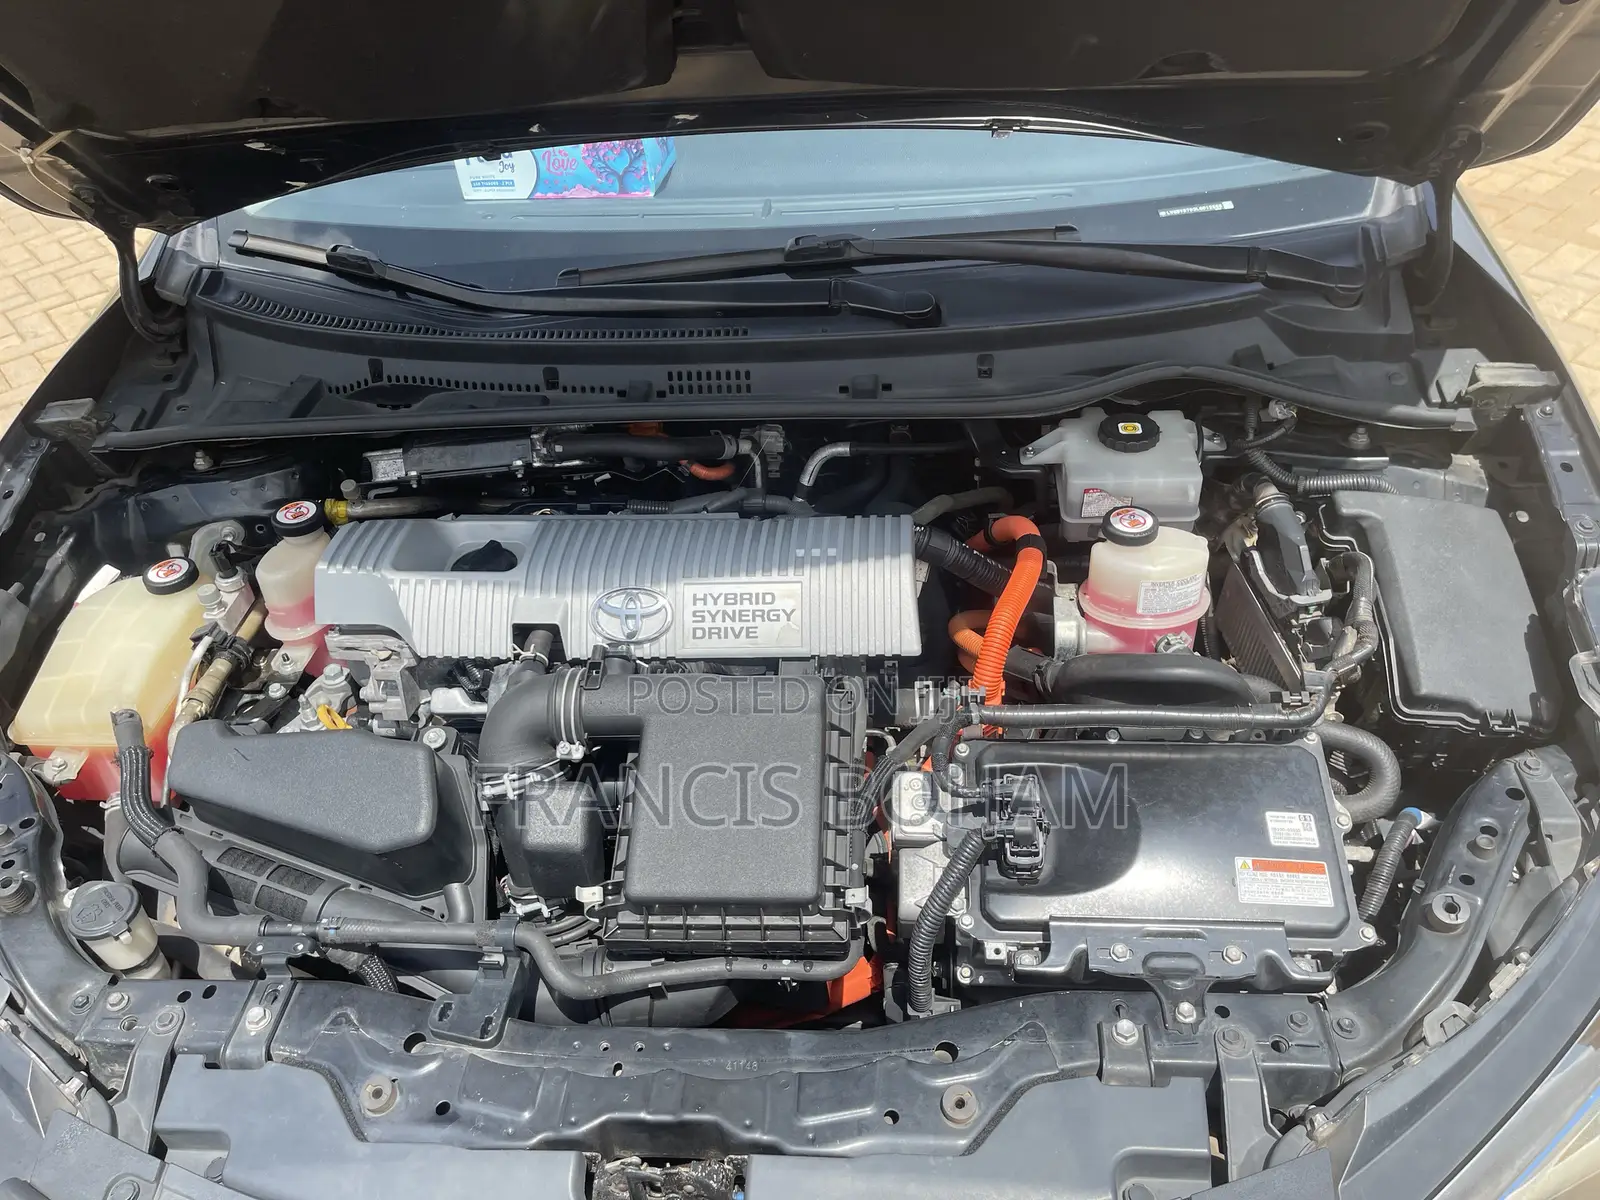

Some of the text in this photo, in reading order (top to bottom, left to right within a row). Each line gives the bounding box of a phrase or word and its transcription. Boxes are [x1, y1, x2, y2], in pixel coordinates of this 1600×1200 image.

[498, 161, 515, 173] Joy
[541, 150, 579, 176] Love
[692, 592, 776, 606] HYBRID
[691, 608, 797, 624] SYNERGY
[691, 625, 759, 641] DRIVE
